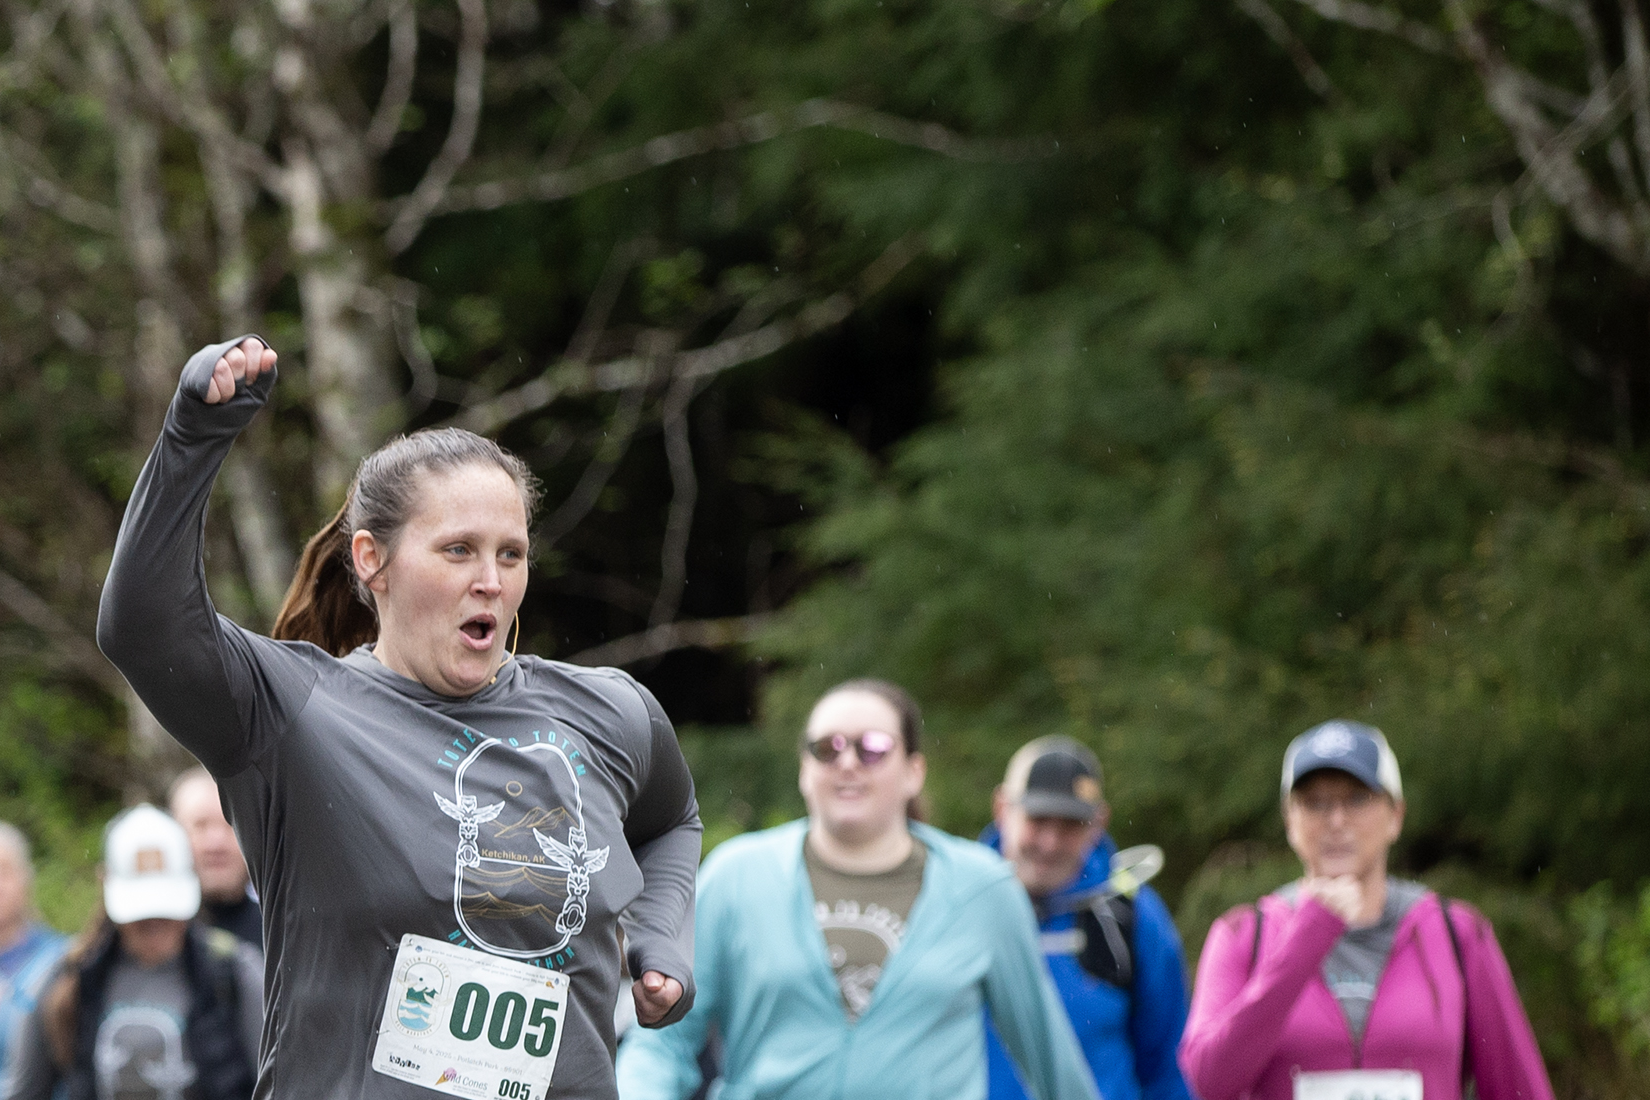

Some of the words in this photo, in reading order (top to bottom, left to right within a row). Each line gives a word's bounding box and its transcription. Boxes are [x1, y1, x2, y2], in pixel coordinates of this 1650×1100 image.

[437, 728, 485, 768] TOTE
[533, 730, 586, 776] TOTEM
[481, 848, 531, 863] Ketchikan,
[532, 854, 546, 864] AK
[449, 982, 559, 1058] 005
[484, 1060, 499, 1070] Park
[444, 1071, 462, 1084] Wild
[462, 1076, 488, 1091] Cones
